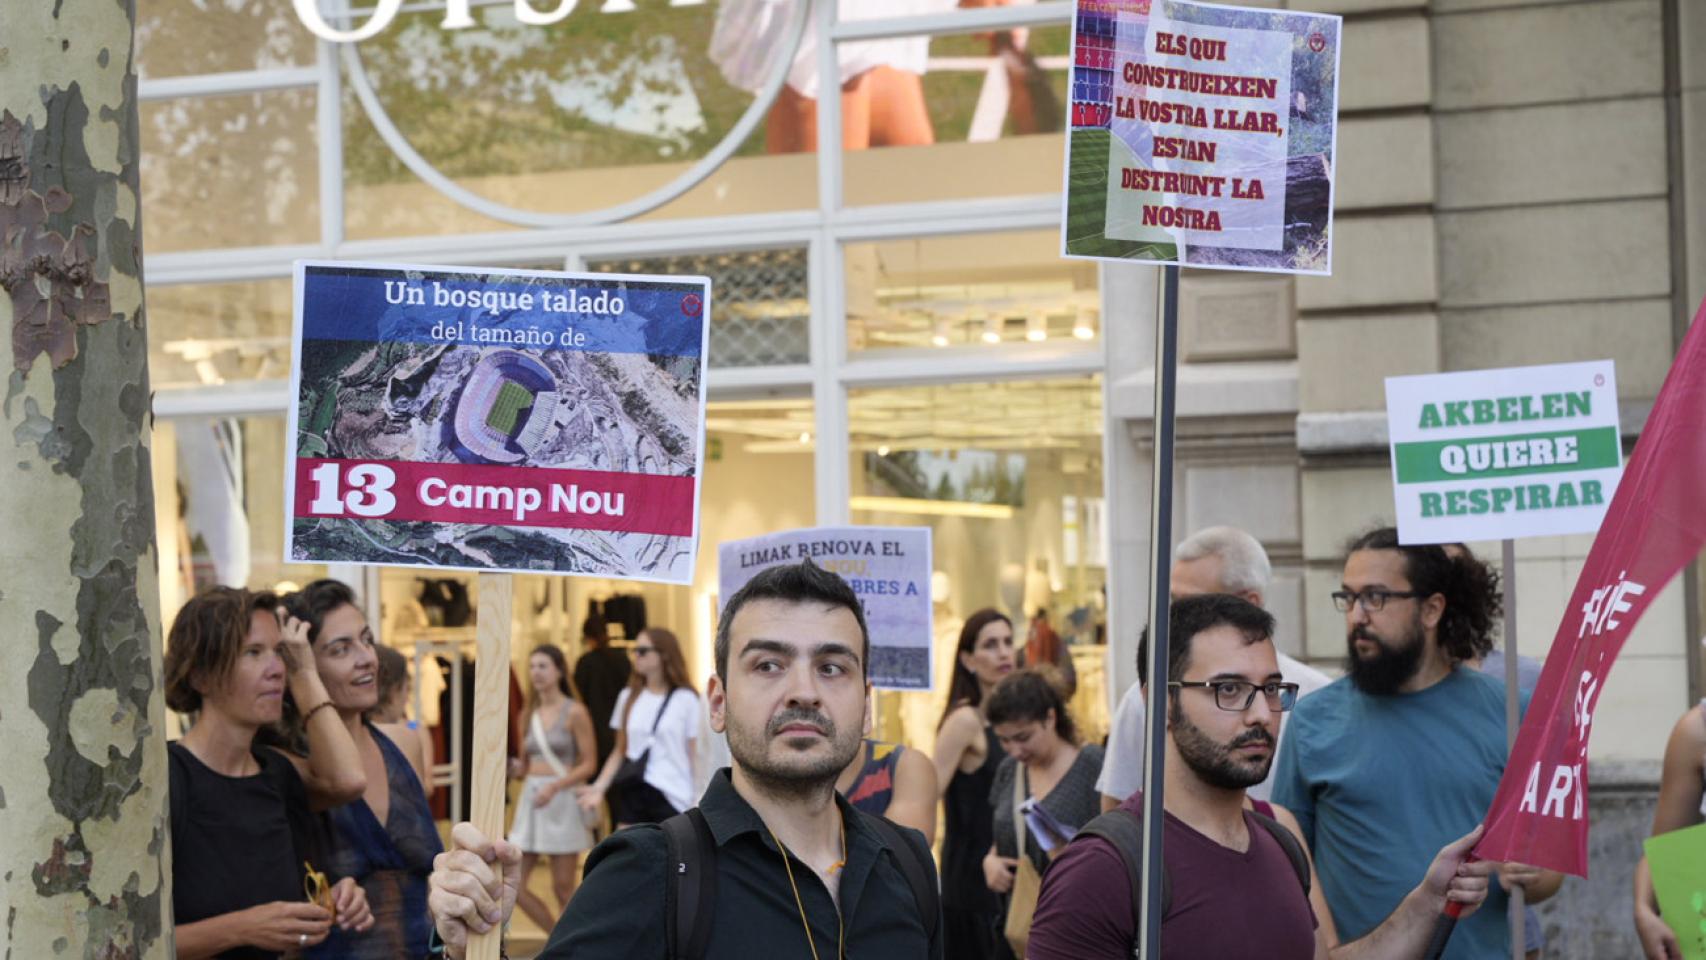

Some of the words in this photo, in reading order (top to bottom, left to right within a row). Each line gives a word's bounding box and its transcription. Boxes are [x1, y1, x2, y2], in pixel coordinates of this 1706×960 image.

[1155, 32, 1187, 56] ELS
[1189, 37, 1227, 61] QUI
[1123, 62, 1277, 99] CONSTRUEIXEN
[1115, 96, 1136, 119] LA
[1138, 100, 1208, 128] VOSTRA
[1213, 108, 1284, 137] LLAR,
[1152, 136, 1217, 162] ESTAN
[1121, 167, 1225, 198] DESTRUINT
[1231, 178, 1265, 200] LA
[1142, 205, 1222, 231] NOSTRA
[384, 281, 425, 305] Un
[433, 281, 534, 316] bosque
[542, 289, 625, 316] talado
[431, 321, 464, 341] del
[470, 324, 554, 346] tamaño
[560, 327, 586, 347] de
[1418, 390, 1592, 429] AKBELEN
[1439, 435, 1579, 474] QUIERE
[310, 463, 396, 516] 13
[417, 476, 541, 520] Camp
[550, 482, 625, 517] Nou
[1419, 479, 1605, 518] RESPIRAR
[740, 545, 792, 568] LIMAK
[797, 540, 875, 558] RENOVA
[882, 541, 905, 557] EL
[905, 581, 919, 596] A
